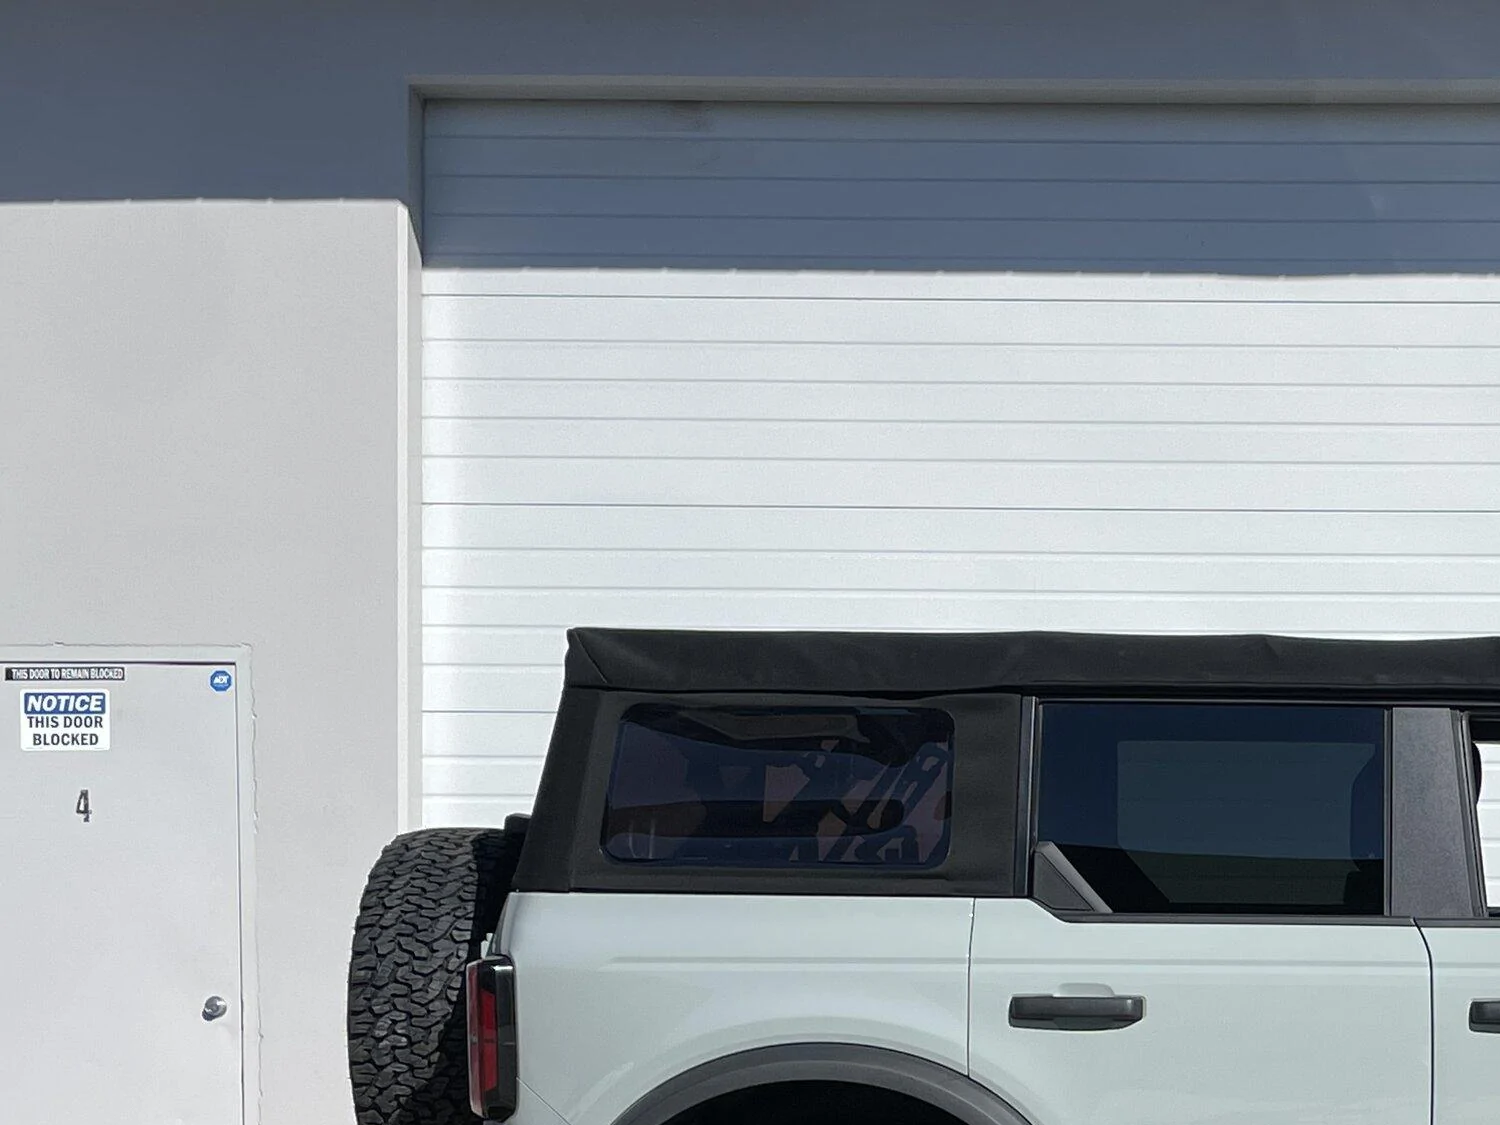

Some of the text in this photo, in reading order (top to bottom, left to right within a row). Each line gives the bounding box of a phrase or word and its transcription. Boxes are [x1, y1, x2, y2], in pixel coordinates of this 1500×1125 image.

[11, 667, 123, 679] THIS DOOR TO REMAIN BLOCKED
[213, 675, 229, 684] ADT
[26, 695, 103, 711] NOTICE
[27, 716, 103, 728] THIS DOOR
[33, 733, 99, 746] BLOCKED
[76, 789, 92, 822] 4
